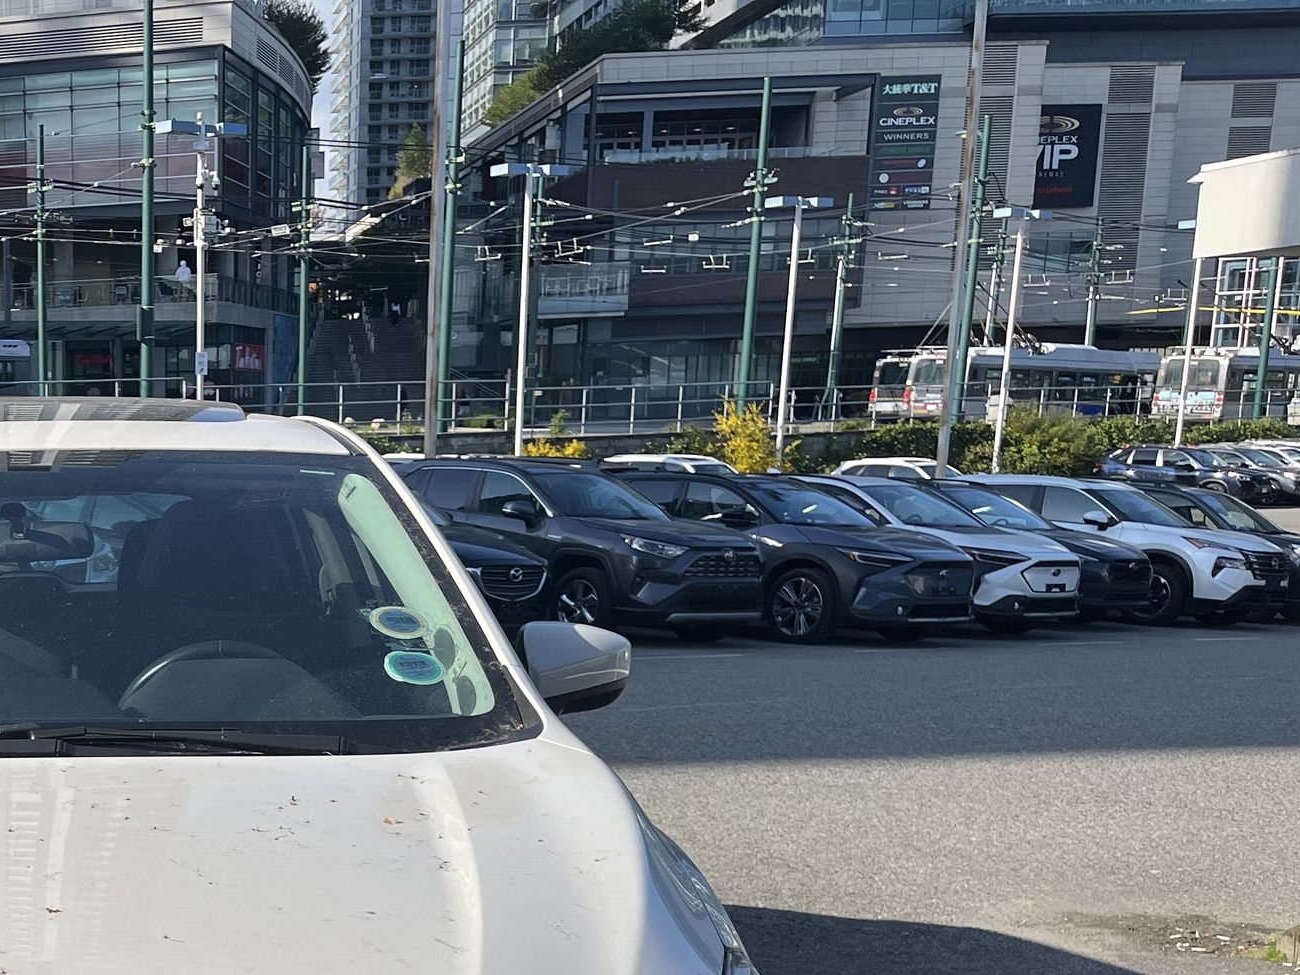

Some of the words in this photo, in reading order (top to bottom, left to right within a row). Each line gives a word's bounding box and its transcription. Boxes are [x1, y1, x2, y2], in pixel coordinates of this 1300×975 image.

[911, 83, 939, 94] T&T
[879, 116, 936, 126] CINEPLEX
[883, 132, 930, 141] WINNERS
[1037, 135, 1079, 144] EPLEX
